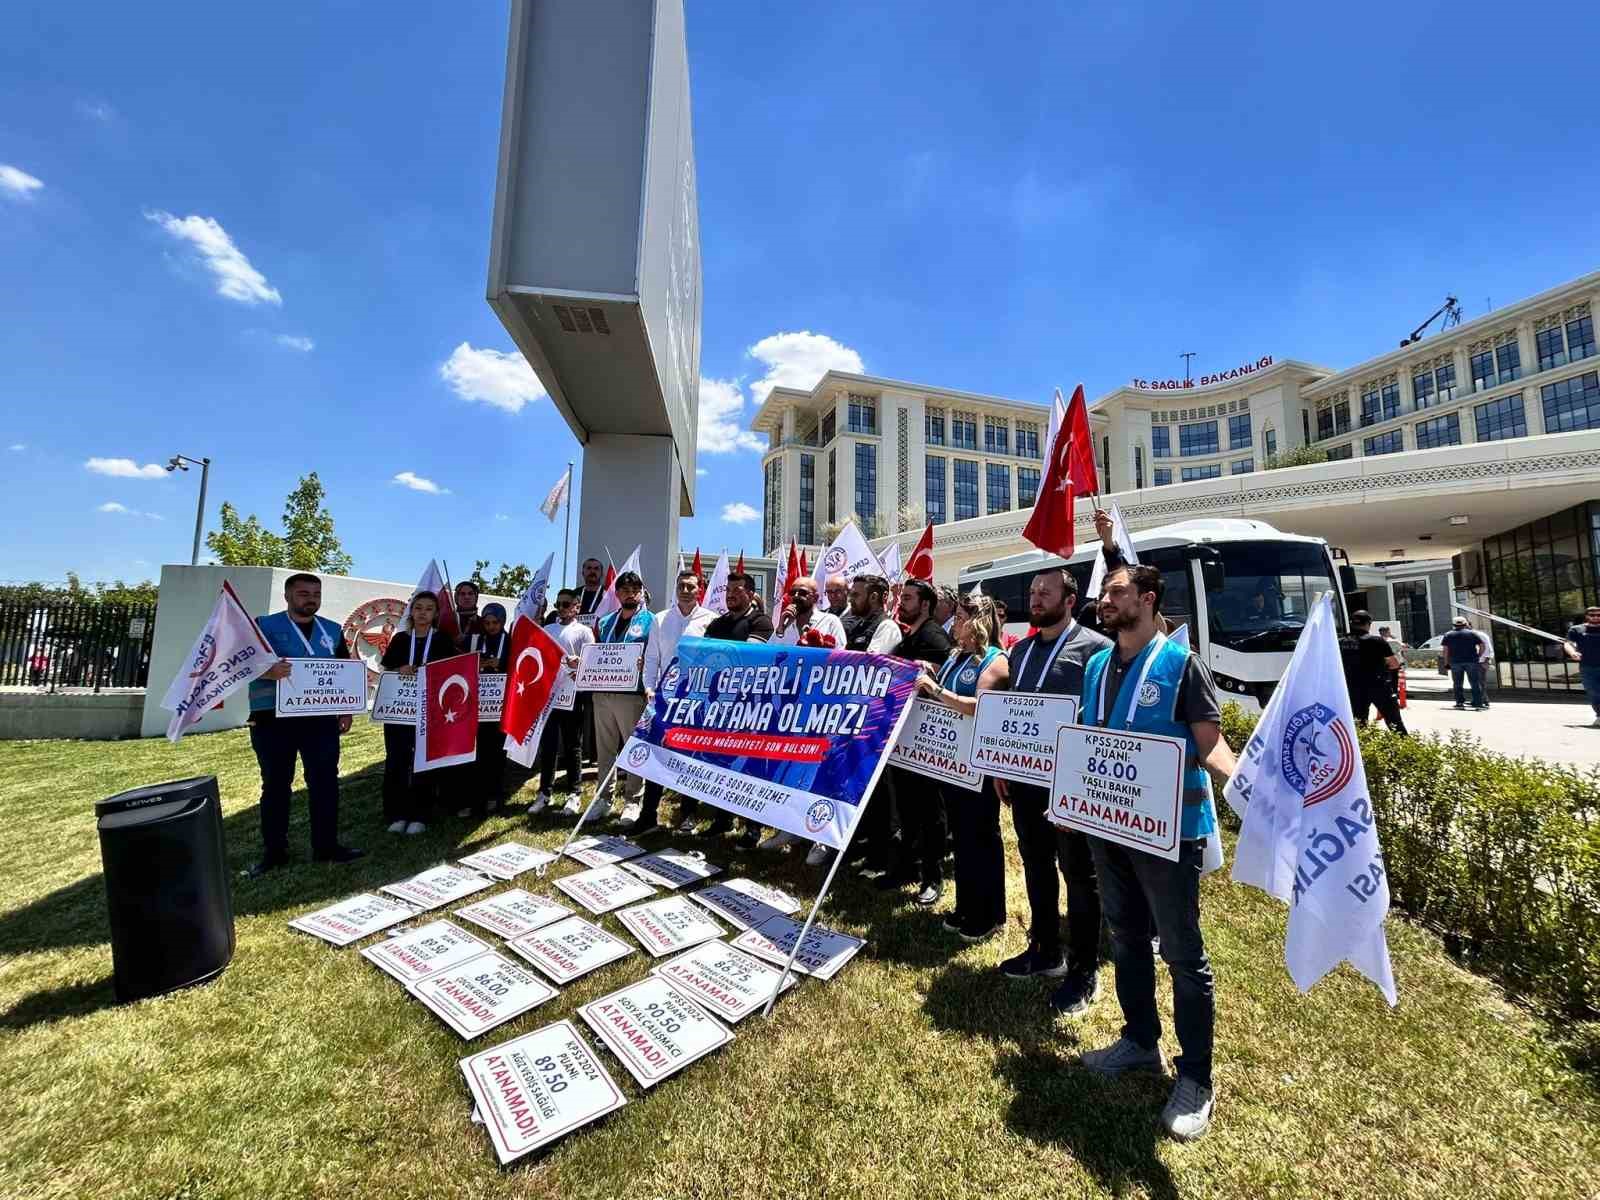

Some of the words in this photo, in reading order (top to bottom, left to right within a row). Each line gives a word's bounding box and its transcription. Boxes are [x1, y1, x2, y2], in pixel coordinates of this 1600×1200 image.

[1200, 355, 1273, 385] BAKANLIĞI
[318, 677, 333, 686] 84
[687, 666, 710, 691] YIL
[717, 659, 801, 700] GEÇERLİ
[806, 664, 894, 698] PUANA
[920, 703, 941, 716] KPSS
[942, 708, 964, 721] 2024
[1003, 697, 1023, 705] KPSS
[1023, 698, 1044, 706] 2024
[662, 698, 699, 725] TEK
[703, 700, 771, 731] ATAMA
[777, 702, 868, 734] OLMAZ!
[1001, 720, 1039, 736] 85.25
[690, 734, 710, 746] KPSS
[765, 741, 781, 752] SON
[783, 742, 821, 755] BULSUN!
[920, 723, 957, 742] 85.50
[1086, 735, 1111, 748] KPSS
[1113, 740, 1142, 752] 2024
[1087, 757, 1137, 781] 86.00
[666, 759, 686, 773] GENÇ
[686, 763, 712, 781] SAĞLIK
[714, 773, 725, 784] VE
[727, 776, 756, 794] SOSYAL
[758, 784, 791, 805] HİZMET
[1082, 775, 1106, 789] YAŞLI
[1109, 780, 1141, 798] BAKIM
[724, 788, 765, 813] SENDİKASI
[1086, 788, 1134, 808] TEKNİKERİ
[1059, 795, 1167, 838] ATANAMADI!
[418, 937, 450, 955] 89.50
[560, 933, 593, 952] 85.75
[712, 960, 752, 983] 86.75
[472, 973, 510, 997] 86.00
[641, 1001, 683, 1035] 90.50
[664, 990, 686, 1006] KPSS
[679, 1003, 706, 1023] 2024
[597, 1002, 669, 1070] ATANAMADI!
[616, 996, 647, 1021] SOSYAL
[637, 1018, 684, 1059] ÇALIŞMACI
[509, 1050, 528, 1069] AĞIZ
[517, 1064, 533, 1078] VE
[564, 1039, 587, 1062] KPSS
[577, 1058, 600, 1081] 2024
[521, 1074, 540, 1090] DİŞ
[532, 1054, 569, 1094] 89.50
[483, 1052, 541, 1141] ATANAMADI!
[528, 1085, 557, 1121] SAĞLIĞI
